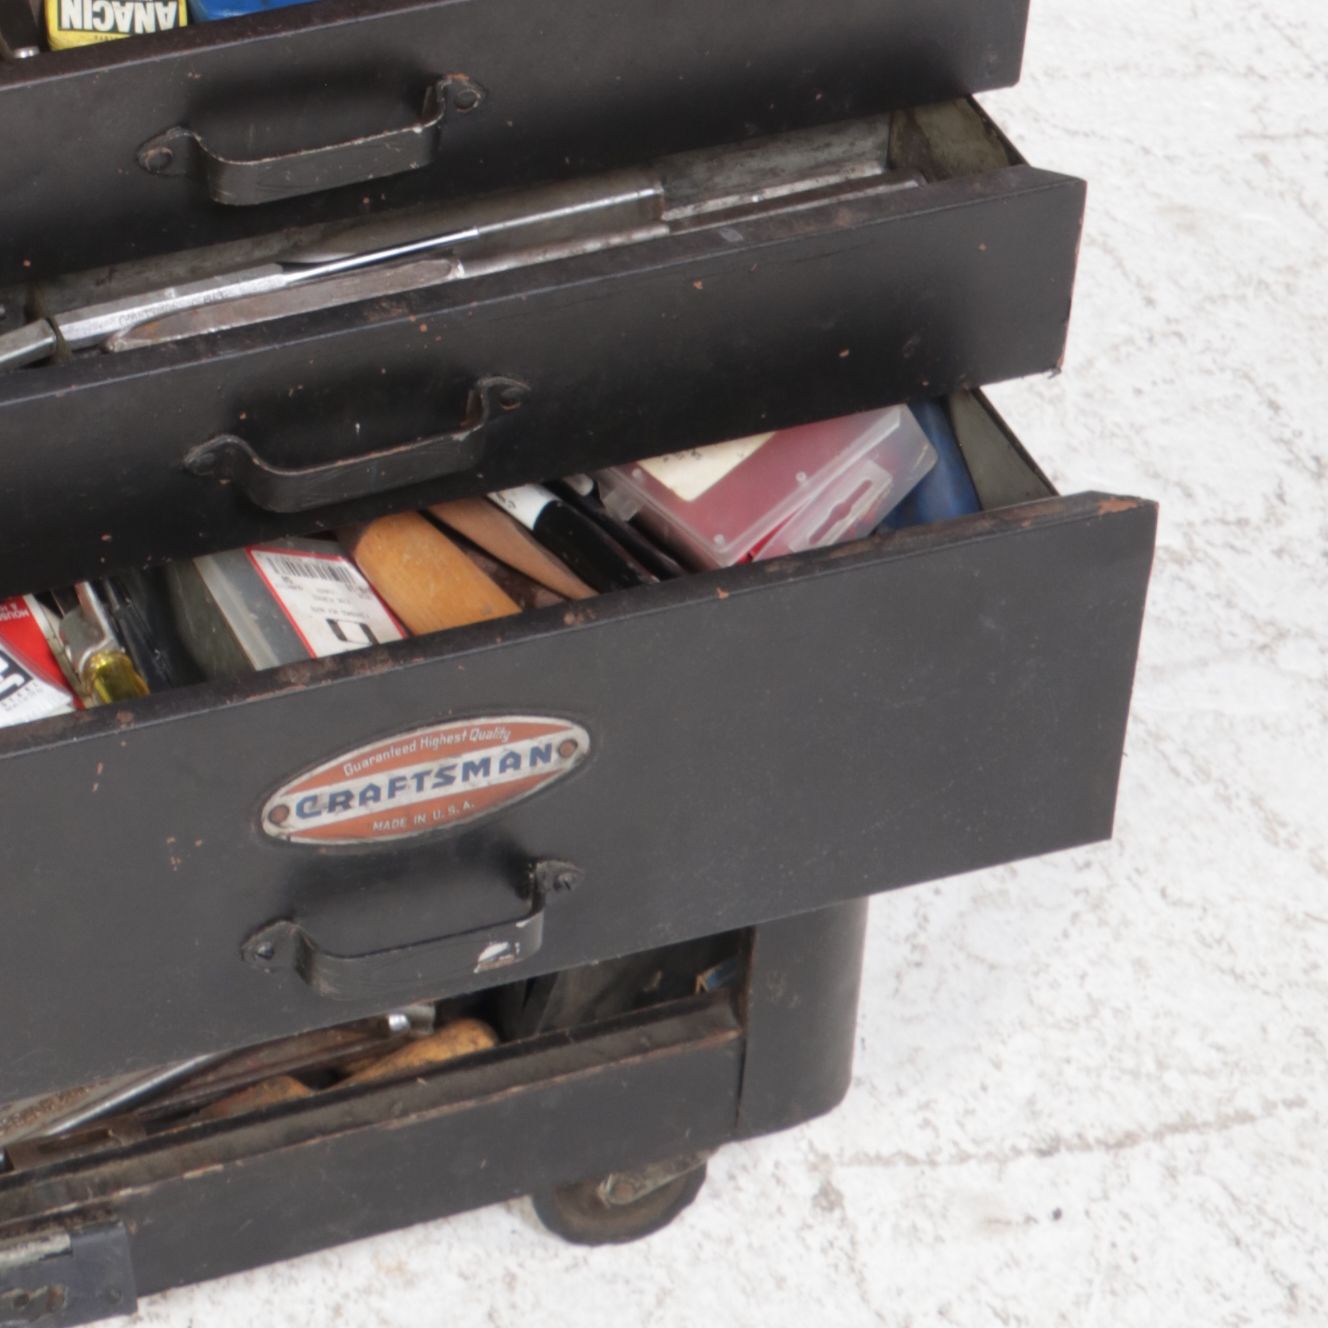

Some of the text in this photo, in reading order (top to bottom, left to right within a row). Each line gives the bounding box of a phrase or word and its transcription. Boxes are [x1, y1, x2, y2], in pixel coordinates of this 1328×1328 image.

[342, 726, 513, 777] Guaranteed Highest Quality
[295, 742, 553, 820] CRAFTSMAN
[372, 816, 408, 832] MADE
[412, 812, 427, 825] IN
